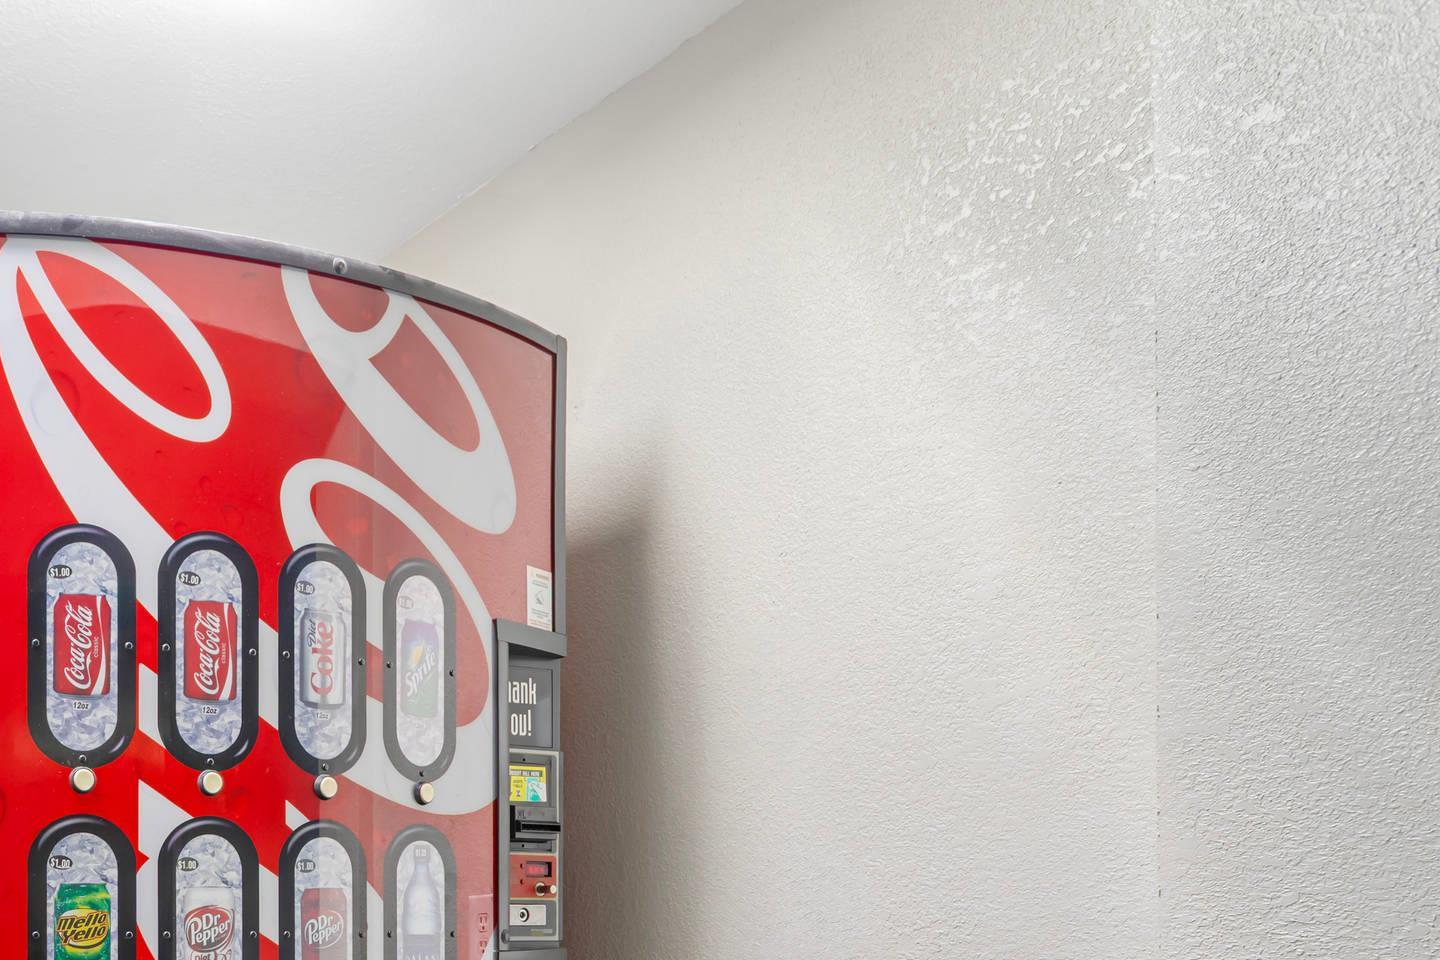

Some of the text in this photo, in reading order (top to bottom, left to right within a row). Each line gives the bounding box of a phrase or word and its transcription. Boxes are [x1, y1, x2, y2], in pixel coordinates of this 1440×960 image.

[50, 567, 71, 577] $1.00
[180, 574, 200, 585] $1.00
[307, 619, 317, 648] Diet
[311, 621, 334, 696] Coke
[405, 650, 436, 697] Sprite
[73, 701, 89, 710] 12oz
[202, 706, 218, 715] 12oz
[50, 857, 71, 869] $1.00
[178, 859, 197, 870] $1.00
[57, 909, 109, 931] Mello
[202, 913, 221, 928] Dr
[316, 914, 334, 931] Dr
[60, 924, 109, 945] Yello
[188, 918, 232, 946] Pepper
[308, 918, 343, 946] Pepper
